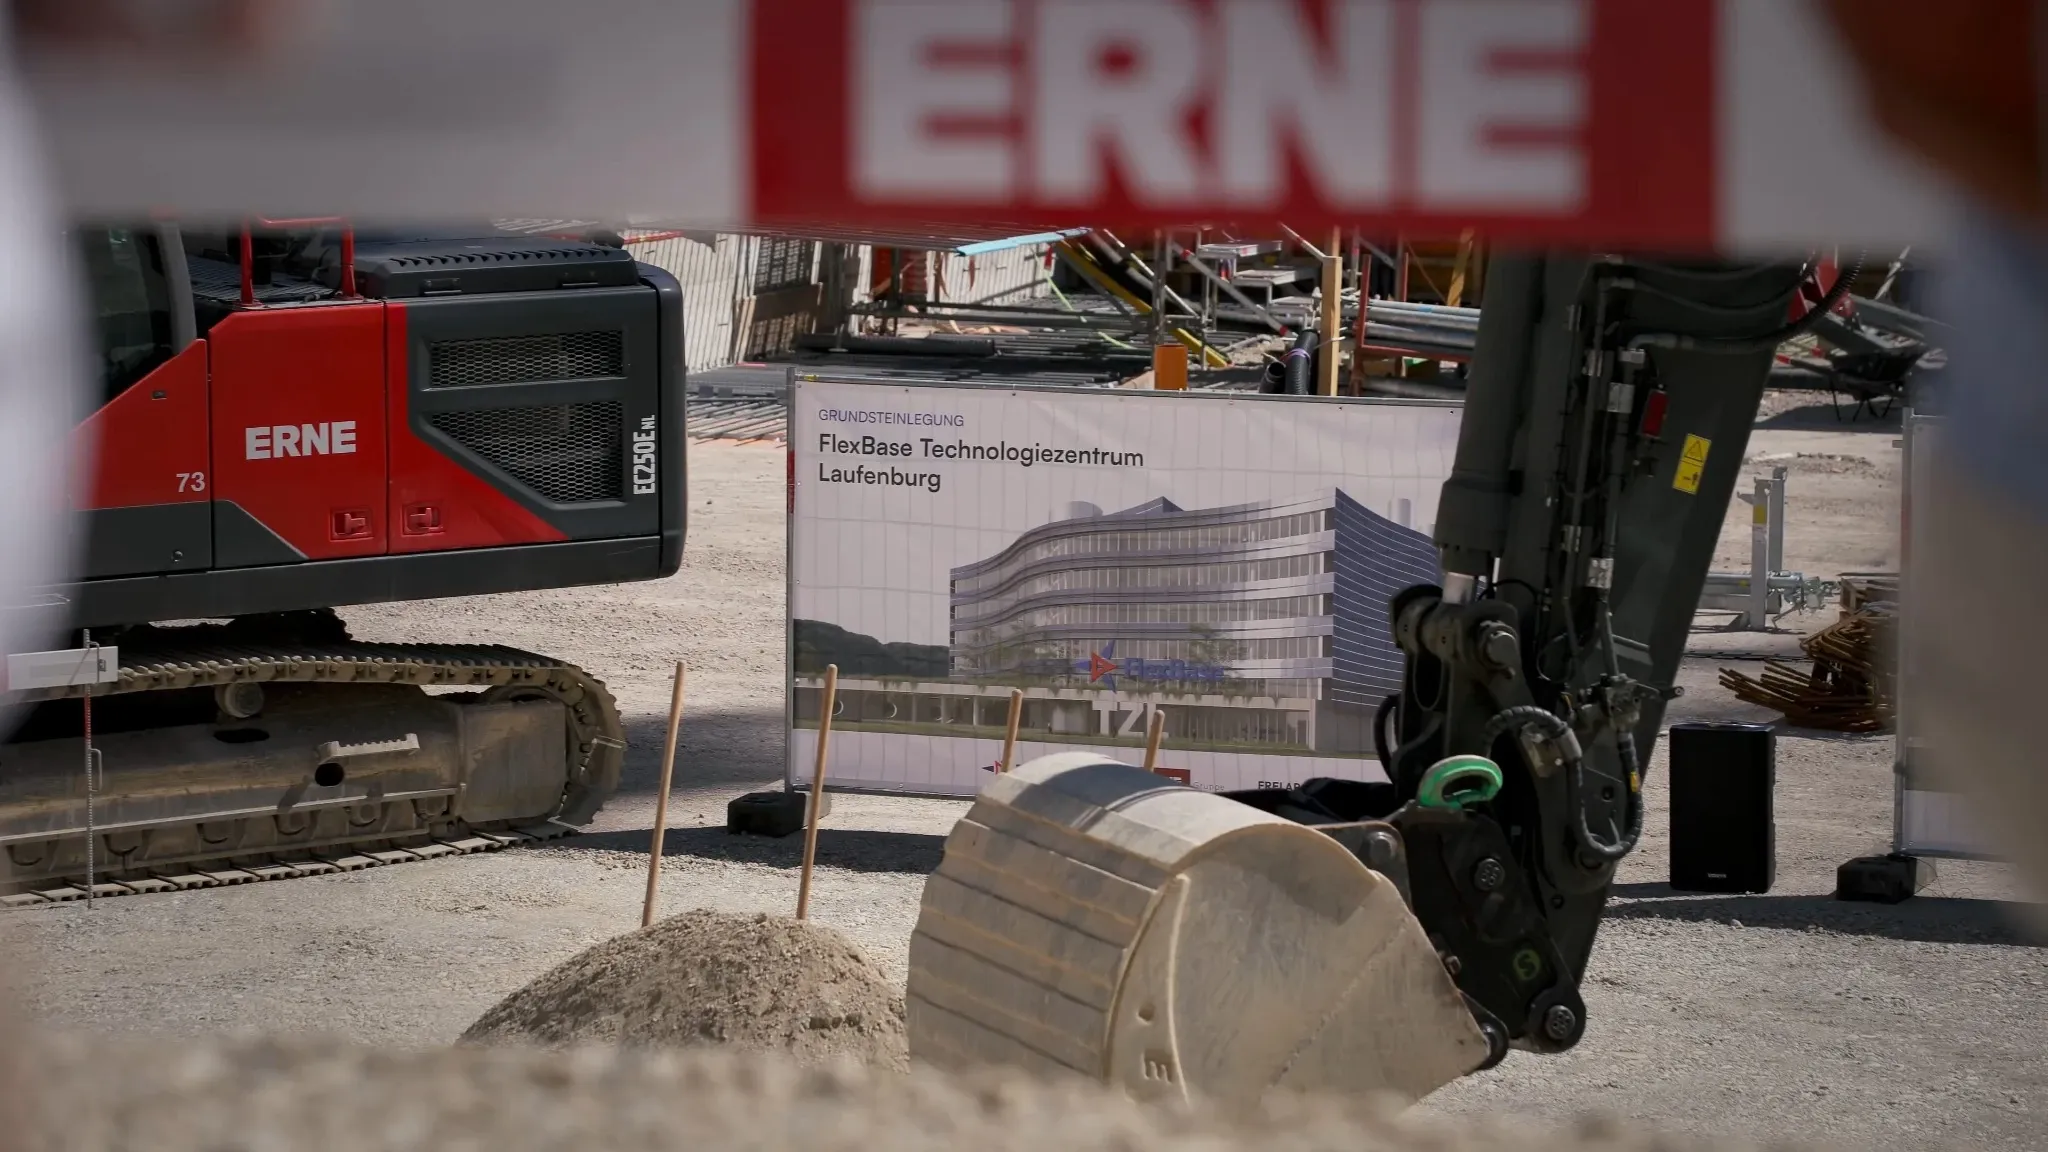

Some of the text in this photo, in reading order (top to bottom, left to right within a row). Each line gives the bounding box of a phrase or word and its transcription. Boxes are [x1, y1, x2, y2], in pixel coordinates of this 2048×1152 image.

[850, 0, 1588, 212] ERNE
[818, 409, 964, 427] GRUNDSTEINLEGUNG
[245, 420, 357, 460] ERNE
[819, 433, 1144, 468] FlexBase Technologiezentrum
[176, 471, 206, 493] 73
[819, 462, 941, 493] Laufenburg
